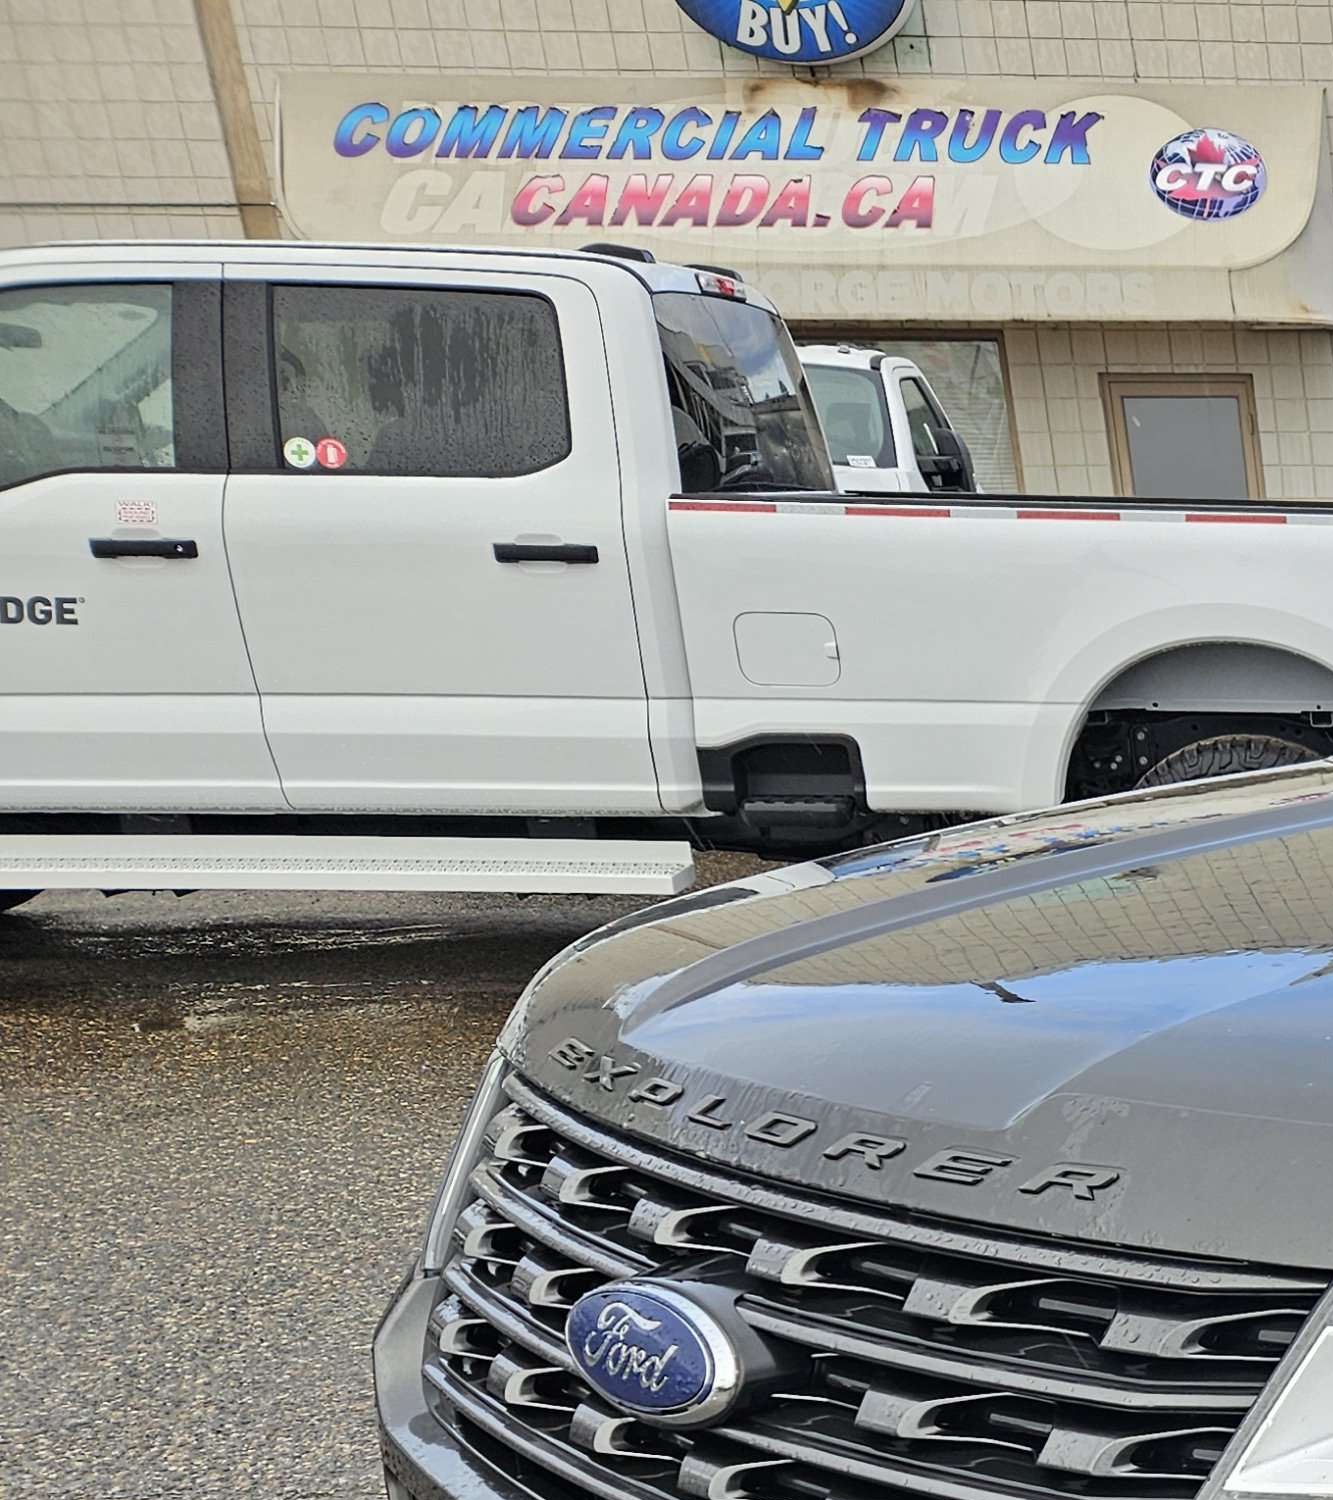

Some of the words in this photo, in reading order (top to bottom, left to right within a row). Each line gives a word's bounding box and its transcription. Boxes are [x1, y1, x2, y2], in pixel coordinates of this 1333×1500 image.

[735, 0, 857, 54] BUY!
[333, 102, 825, 161] COMMERCIAL
[856, 106, 1105, 164] TRUCK
[510, 172, 936, 229] CANADA.CA
[1156, 161, 1258, 193] CTC
[744, 269, 913, 314] ORGE
[547, 1036, 1121, 1200] EXPLORER
[584, 1302, 680, 1392] Ford
